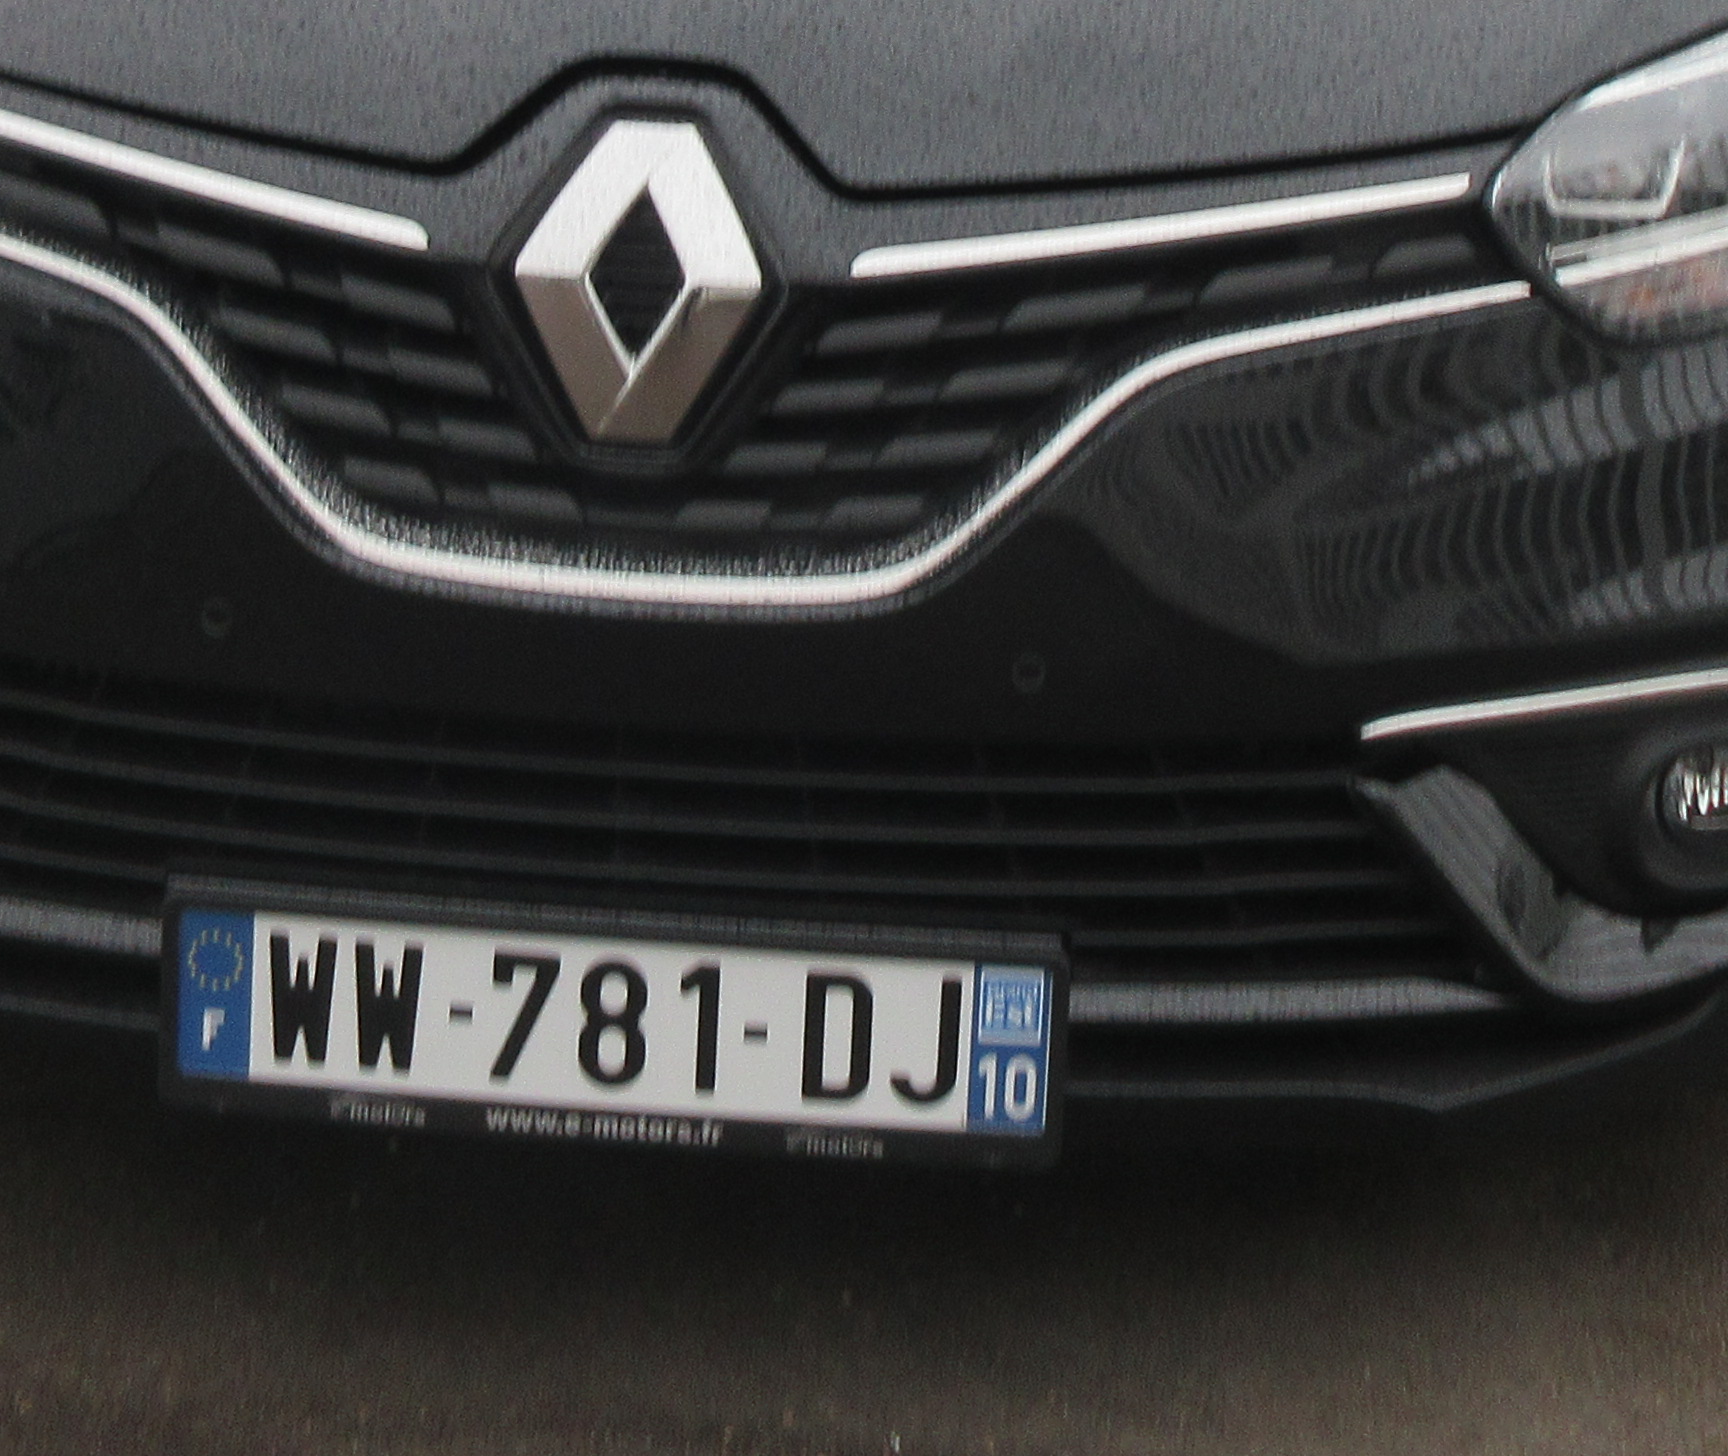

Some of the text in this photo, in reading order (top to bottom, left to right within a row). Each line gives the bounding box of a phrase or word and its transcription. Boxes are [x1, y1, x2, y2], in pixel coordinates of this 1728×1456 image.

[201, 1007, 225, 1051] F
[269, 928, 963, 1110] WW-781-DJ
[978, 1052, 1037, 1122] 10
